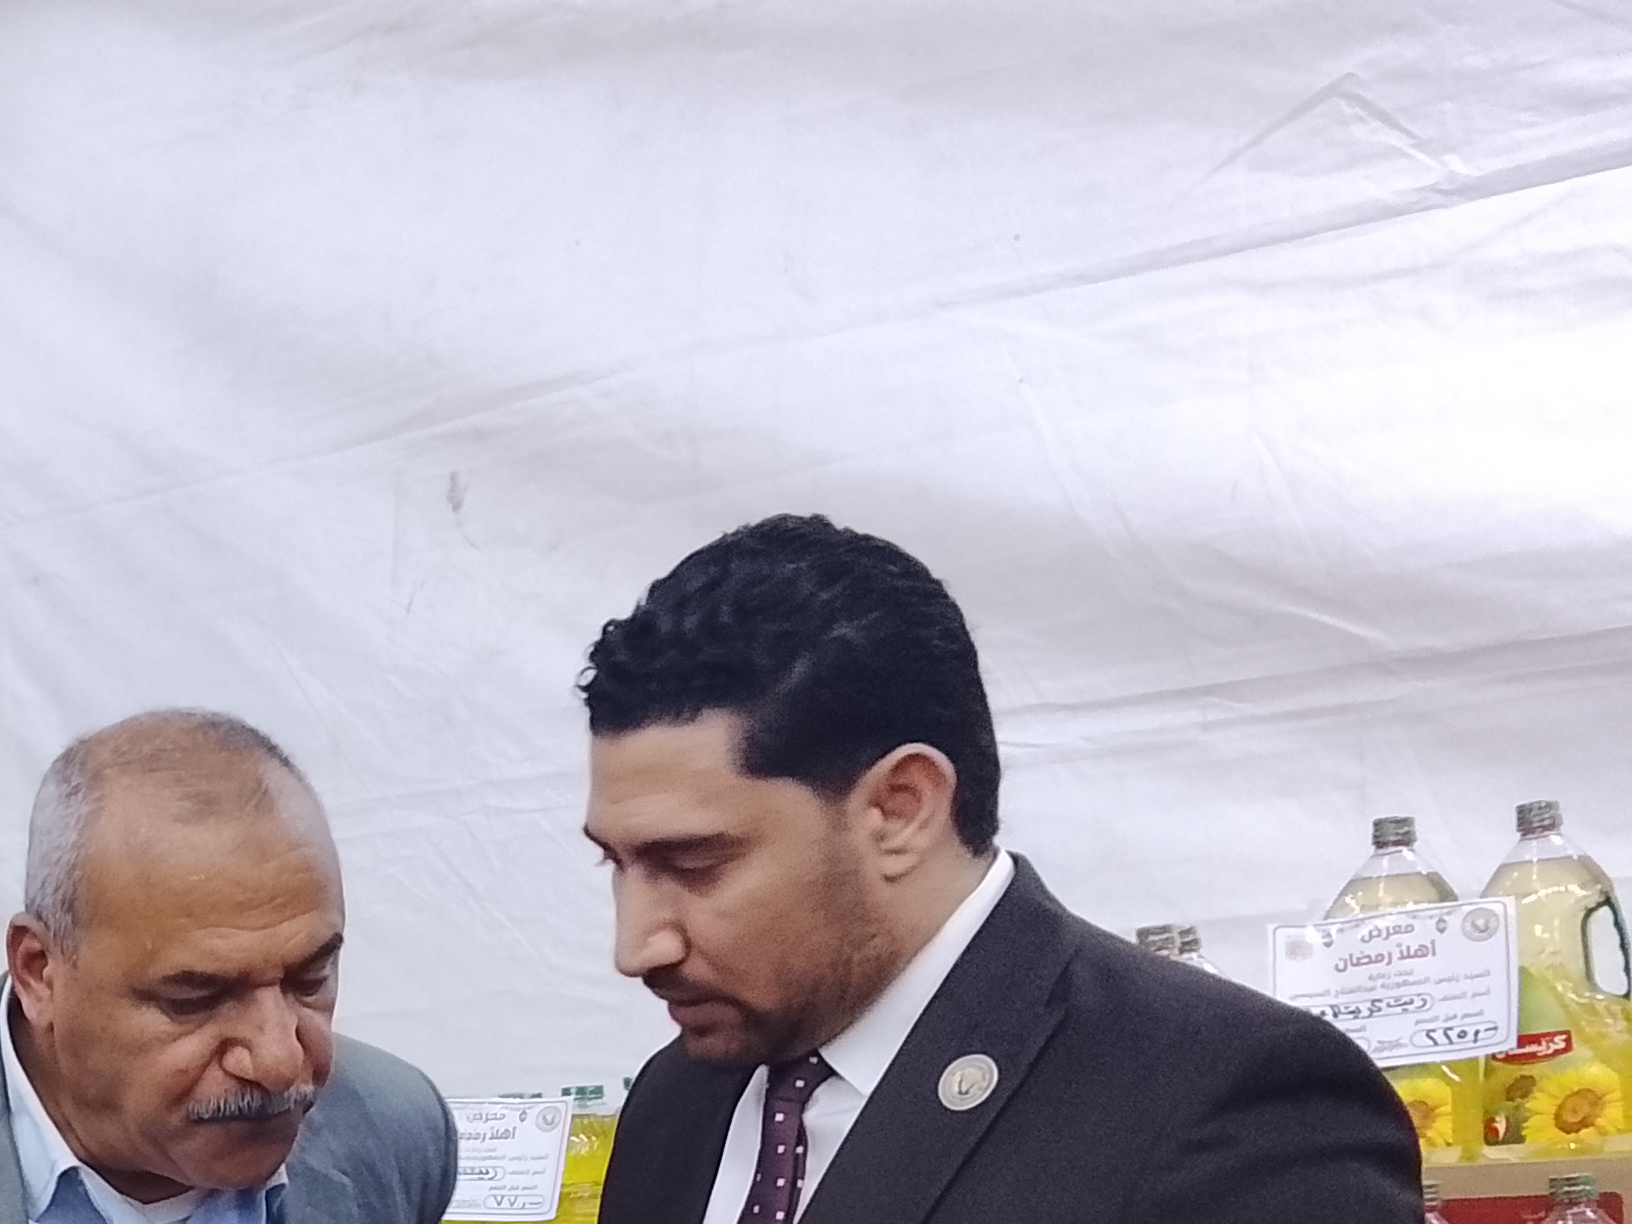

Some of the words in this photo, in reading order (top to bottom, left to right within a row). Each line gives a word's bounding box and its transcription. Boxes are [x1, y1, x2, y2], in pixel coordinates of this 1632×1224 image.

[1360, 923, 1415, 943] معرض
[1334, 949, 1392, 973] رمضان
[1494, 1034, 1569, 1059] كريس
